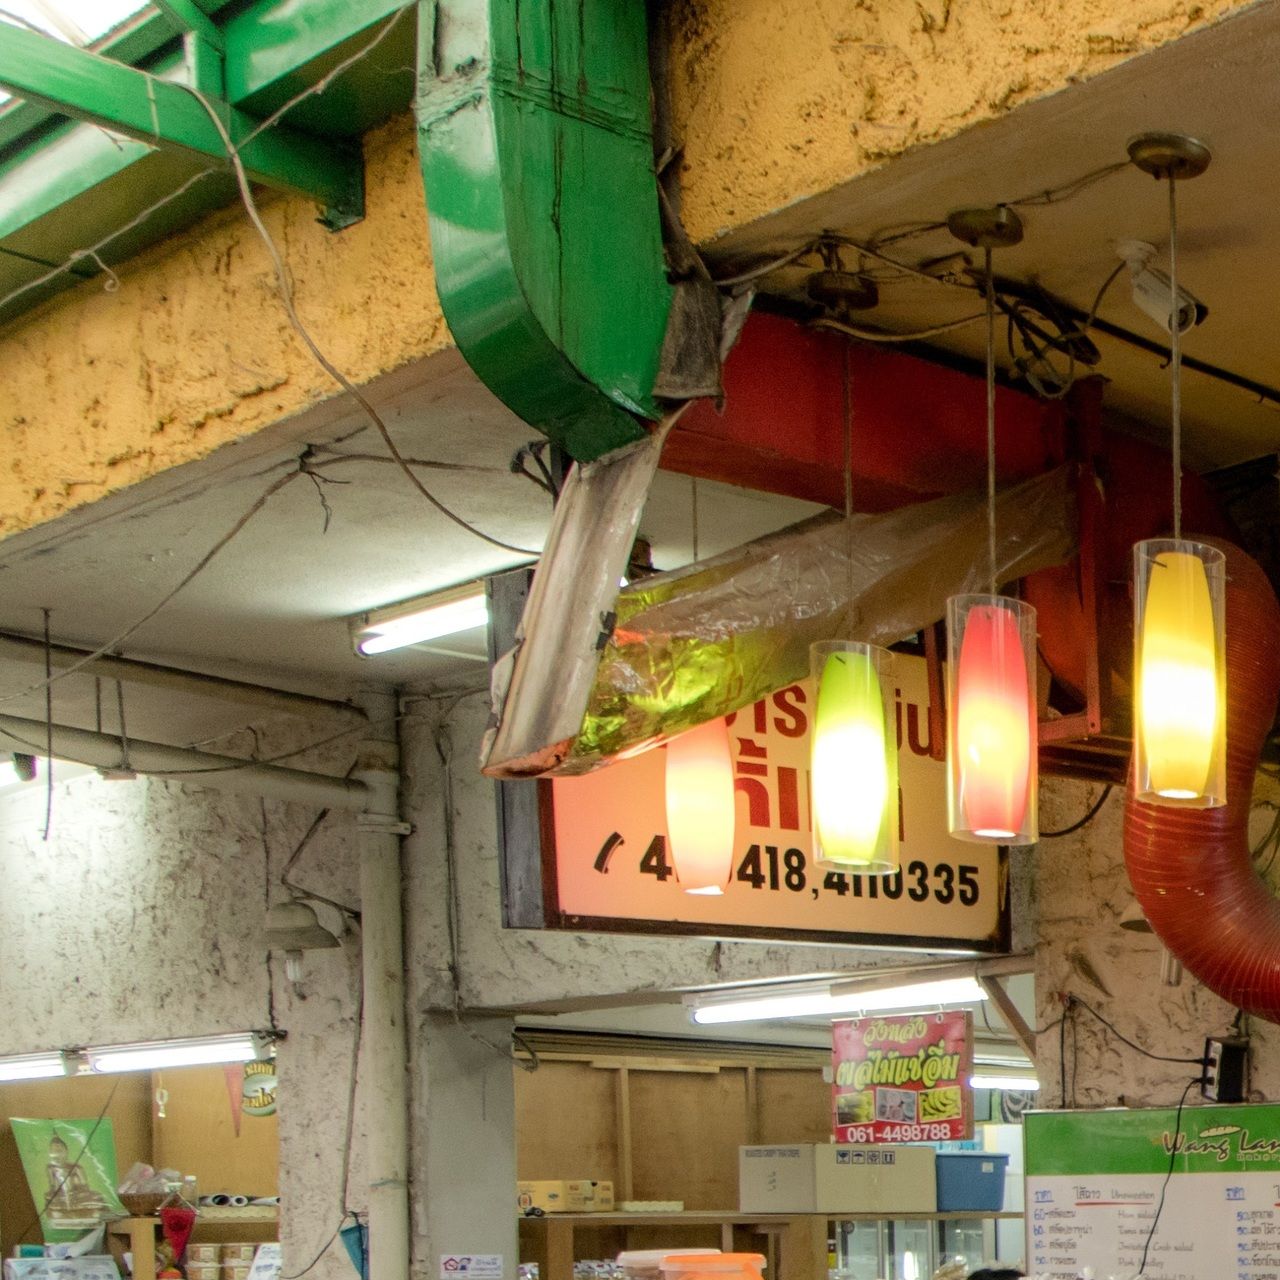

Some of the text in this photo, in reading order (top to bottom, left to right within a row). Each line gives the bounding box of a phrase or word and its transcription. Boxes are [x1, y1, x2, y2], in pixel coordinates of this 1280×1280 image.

[863, 1017, 928, 1047] วังหลัง
[836, 1039, 961, 1090] ผลไม้แช่อิ่ม
[847, 1123, 951, 1143] 061-4498788
[1163, 1131, 1229, 1162] Wang
